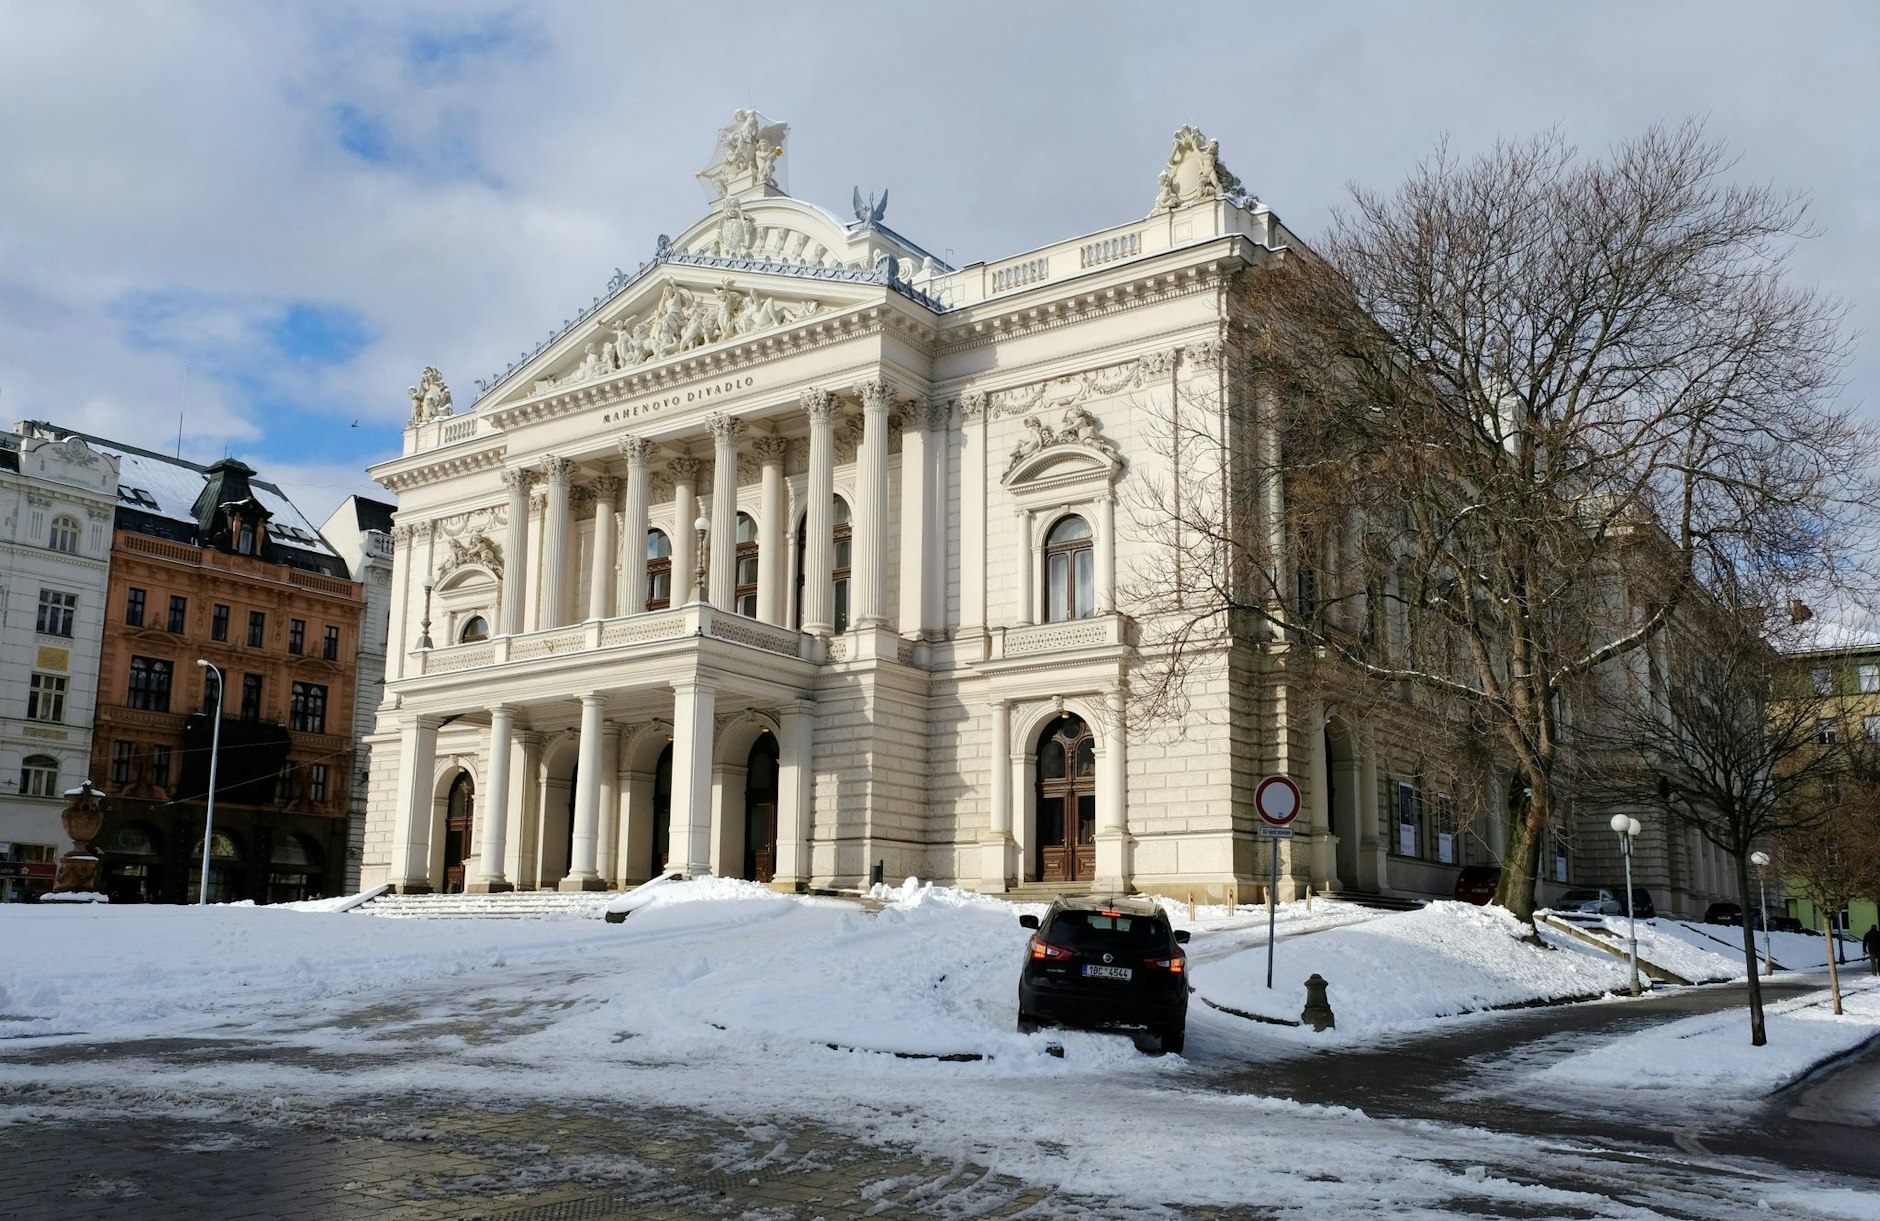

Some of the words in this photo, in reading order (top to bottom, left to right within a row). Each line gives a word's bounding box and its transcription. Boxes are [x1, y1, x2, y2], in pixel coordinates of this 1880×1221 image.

[602, 396, 680, 424] MAHENOVO
[687, 376, 754, 402] DIVADLO
[1108, 968, 1128, 978] 4544
